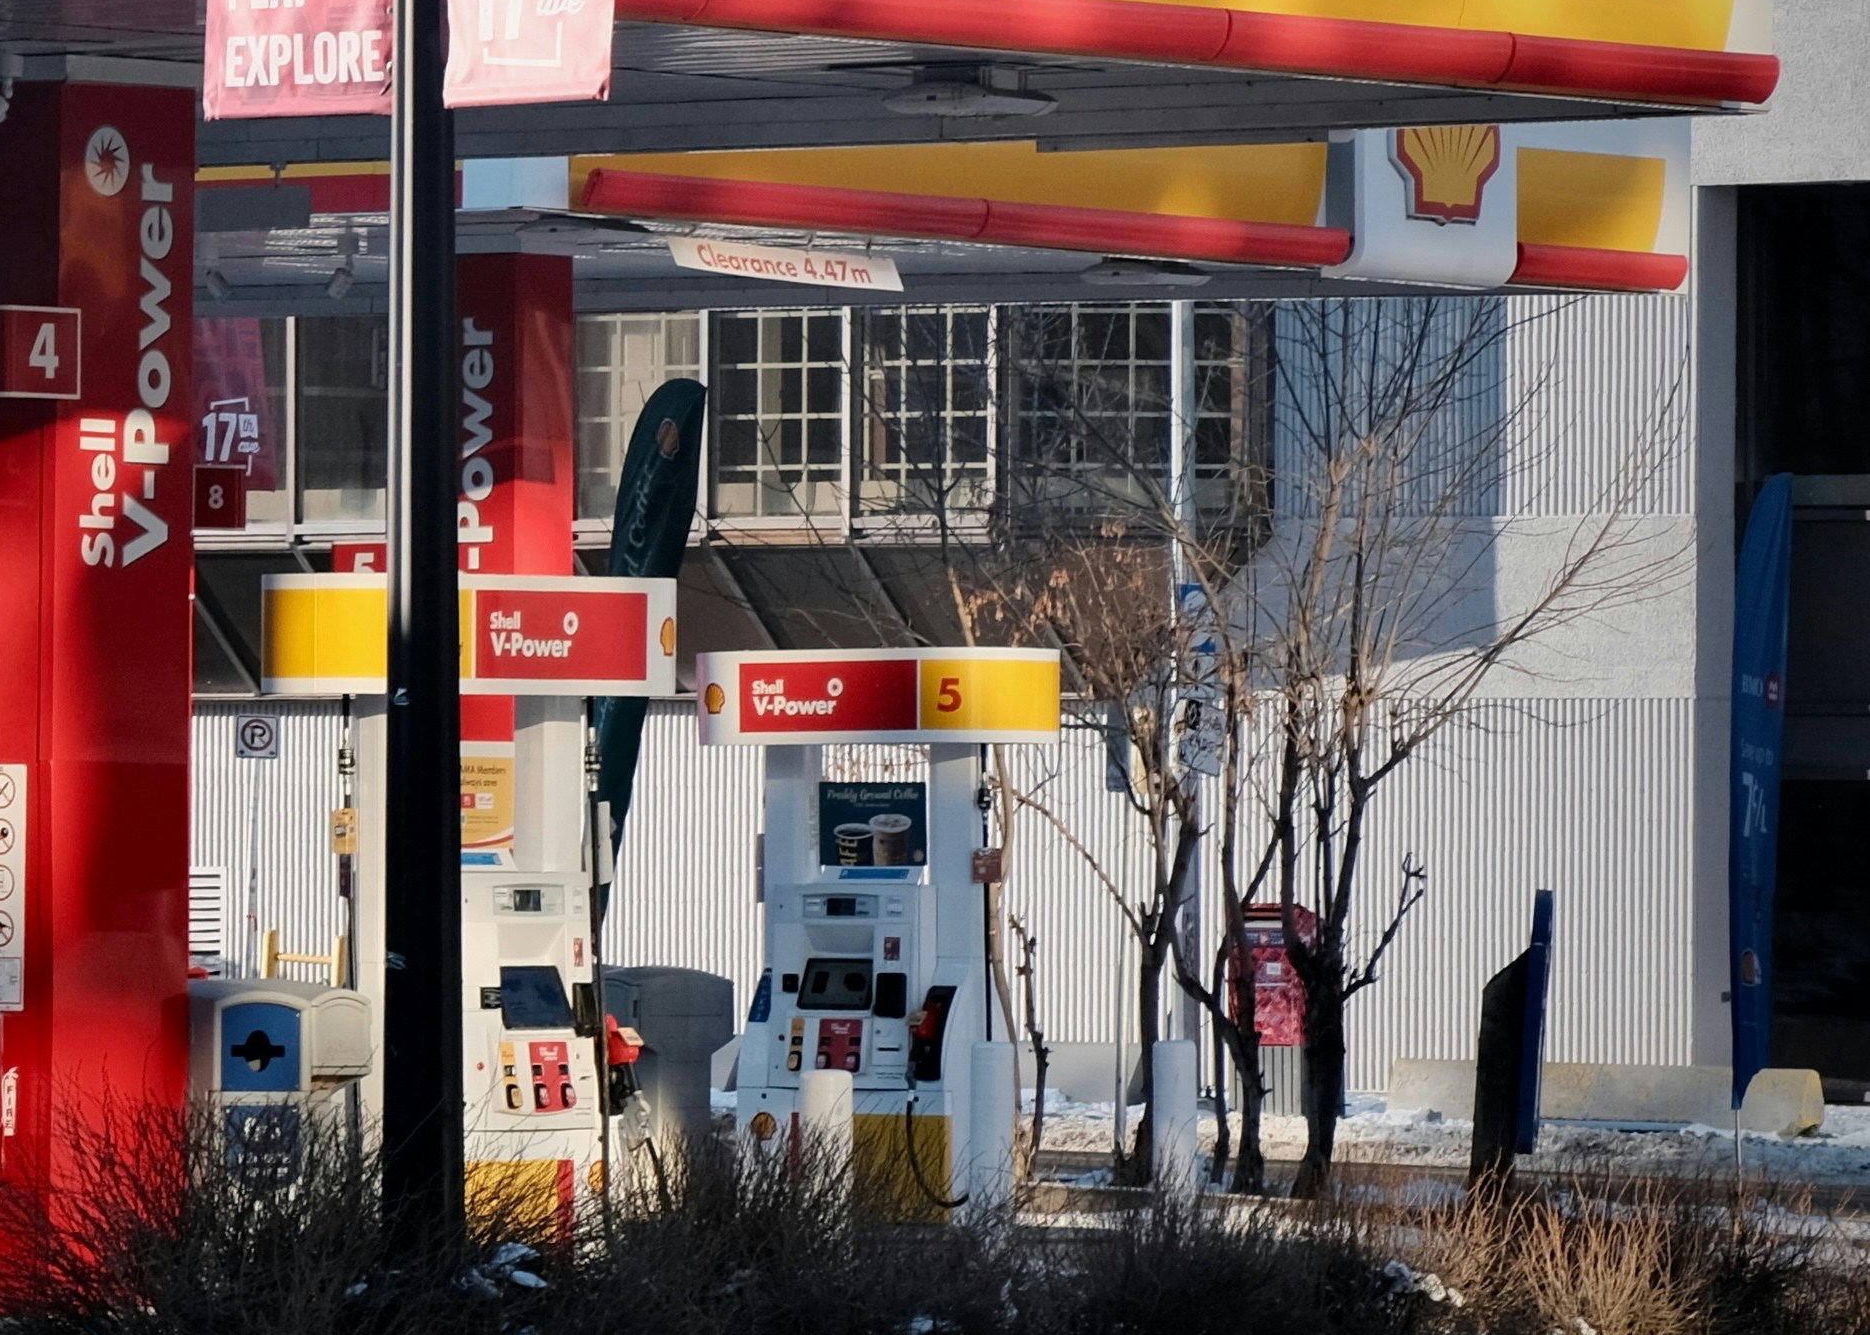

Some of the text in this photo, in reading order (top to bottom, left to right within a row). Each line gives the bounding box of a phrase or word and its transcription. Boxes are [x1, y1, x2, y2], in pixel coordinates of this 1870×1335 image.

[224, 30, 384, 87] EXPLORE
[697, 244, 872, 284] Clearance 4.47m
[28, 323, 59, 379] 4
[122, 163, 174, 568] V-Power
[202, 413, 237, 462] 17
[457, 317, 493, 570] -Power
[80, 419, 116, 568] Shell
[208, 485, 224, 509] 8
[490, 612, 520, 631] Shell
[491, 632, 572, 659] V-Power
[751, 679, 783, 695] Shell
[753, 696, 837, 716] V-Power
[937, 677, 962, 713] 5
[6, 1085, 14, 1129] FIRE
